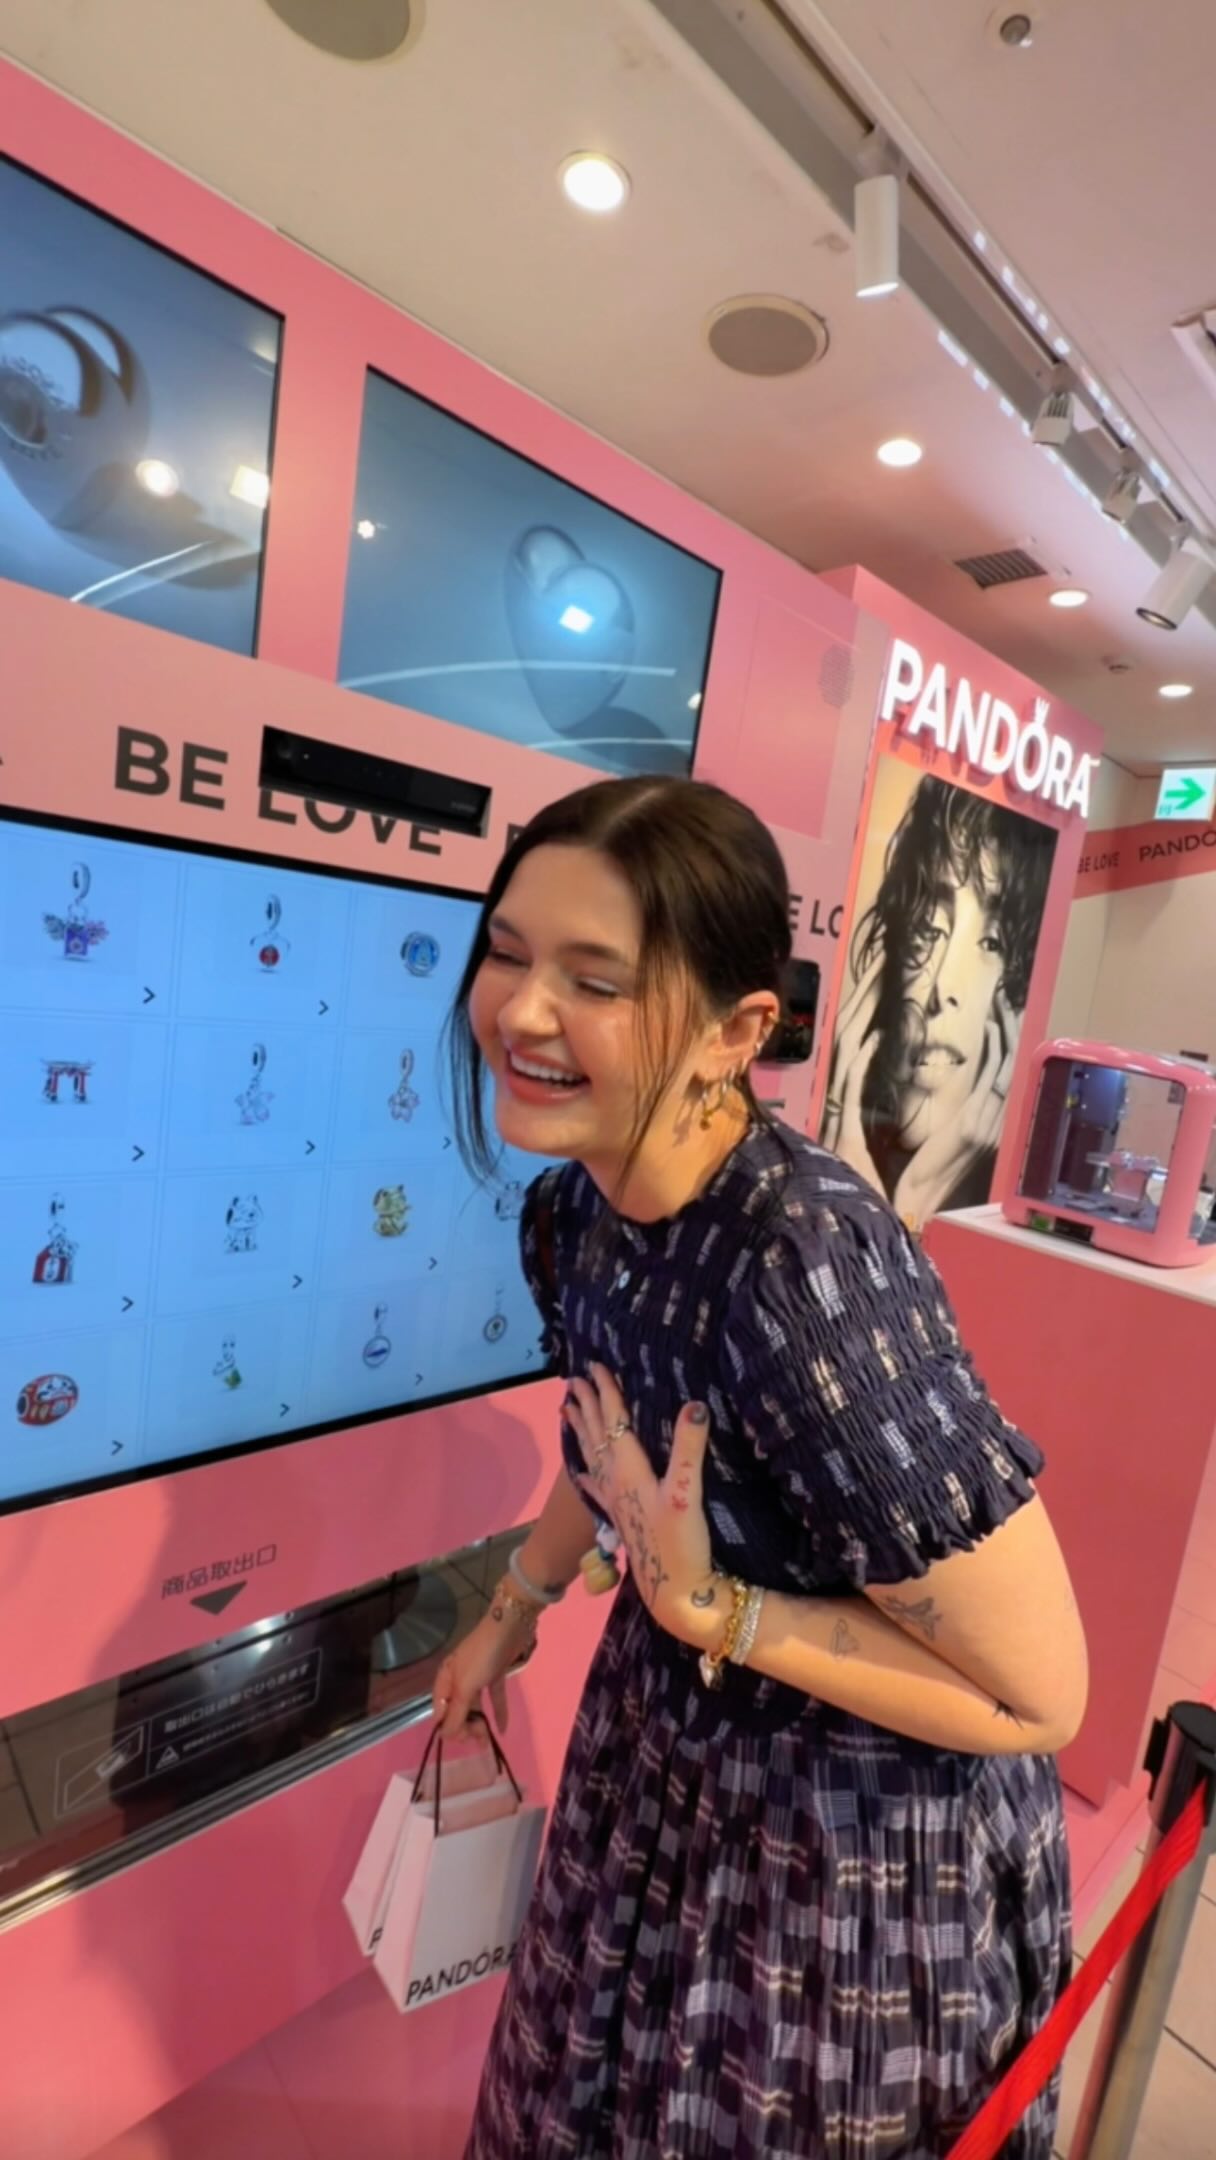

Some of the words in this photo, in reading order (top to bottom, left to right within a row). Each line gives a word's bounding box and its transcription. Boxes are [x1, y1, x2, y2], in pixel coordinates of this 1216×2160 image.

[881, 638, 1089, 818] PANDORA
[115, 725, 229, 810] BE
[1093, 851, 1120, 871] LOVE
[161, 1543, 277, 1600] 商品取出口
